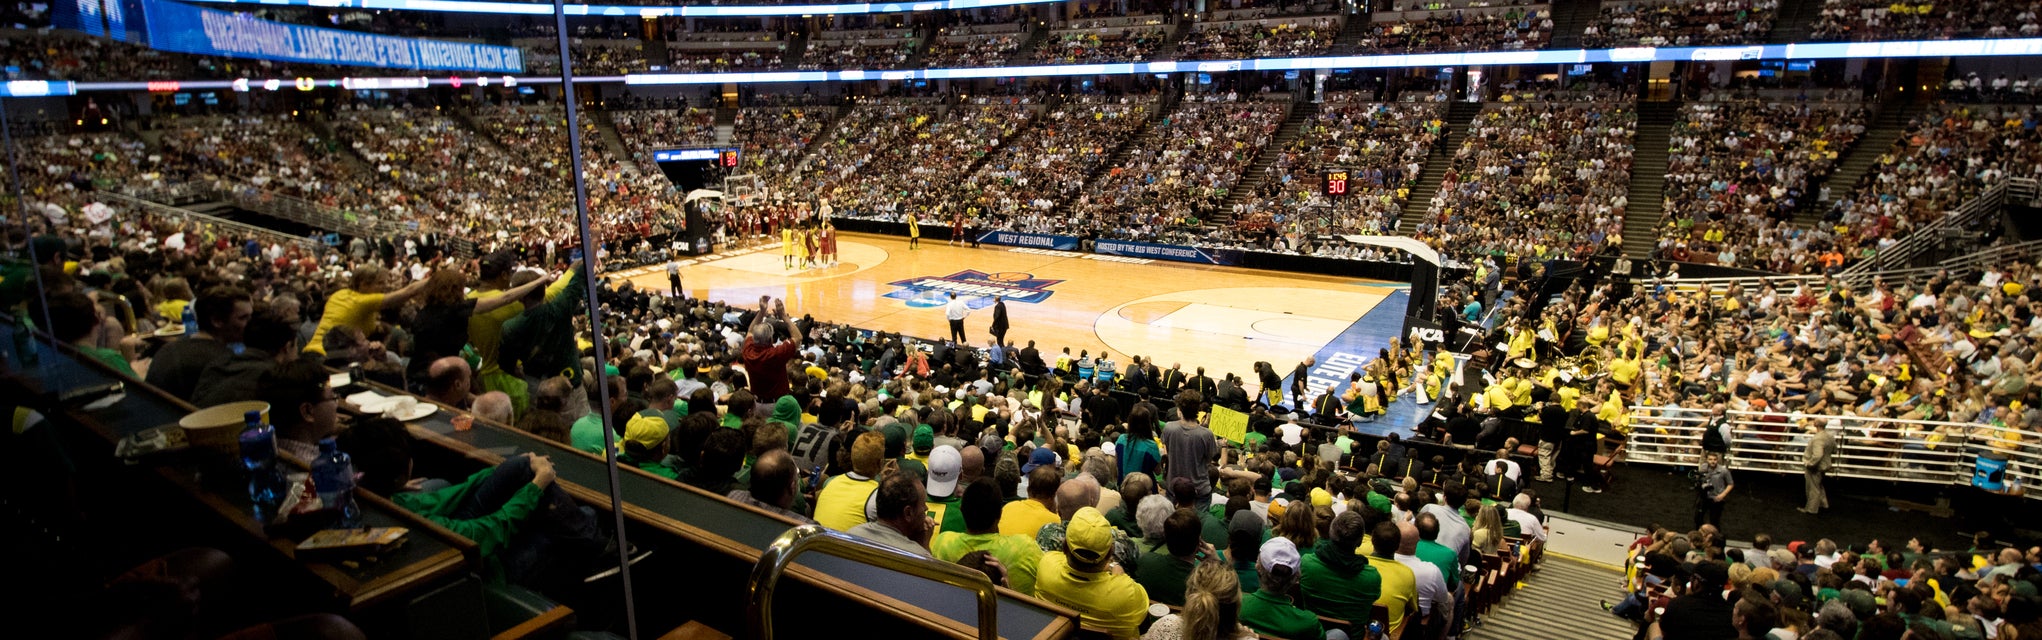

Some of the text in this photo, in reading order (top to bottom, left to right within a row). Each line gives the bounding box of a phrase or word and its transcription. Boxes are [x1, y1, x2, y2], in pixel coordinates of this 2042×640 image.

[1329, 180, 1345, 193] 30
[998, 233, 1054, 247] WEST REGIONAL
[1097, 242, 1117, 251] HOSTED
[1125, 244, 1135, 253] THE
[1135, 245, 1145, 253] BIG
[1146, 246, 1162, 255] WEST
[1161, 248, 1197, 258] CONFERENCE
[1313, 352, 1367, 380] ELITE
[791, 426, 829, 462] 21
